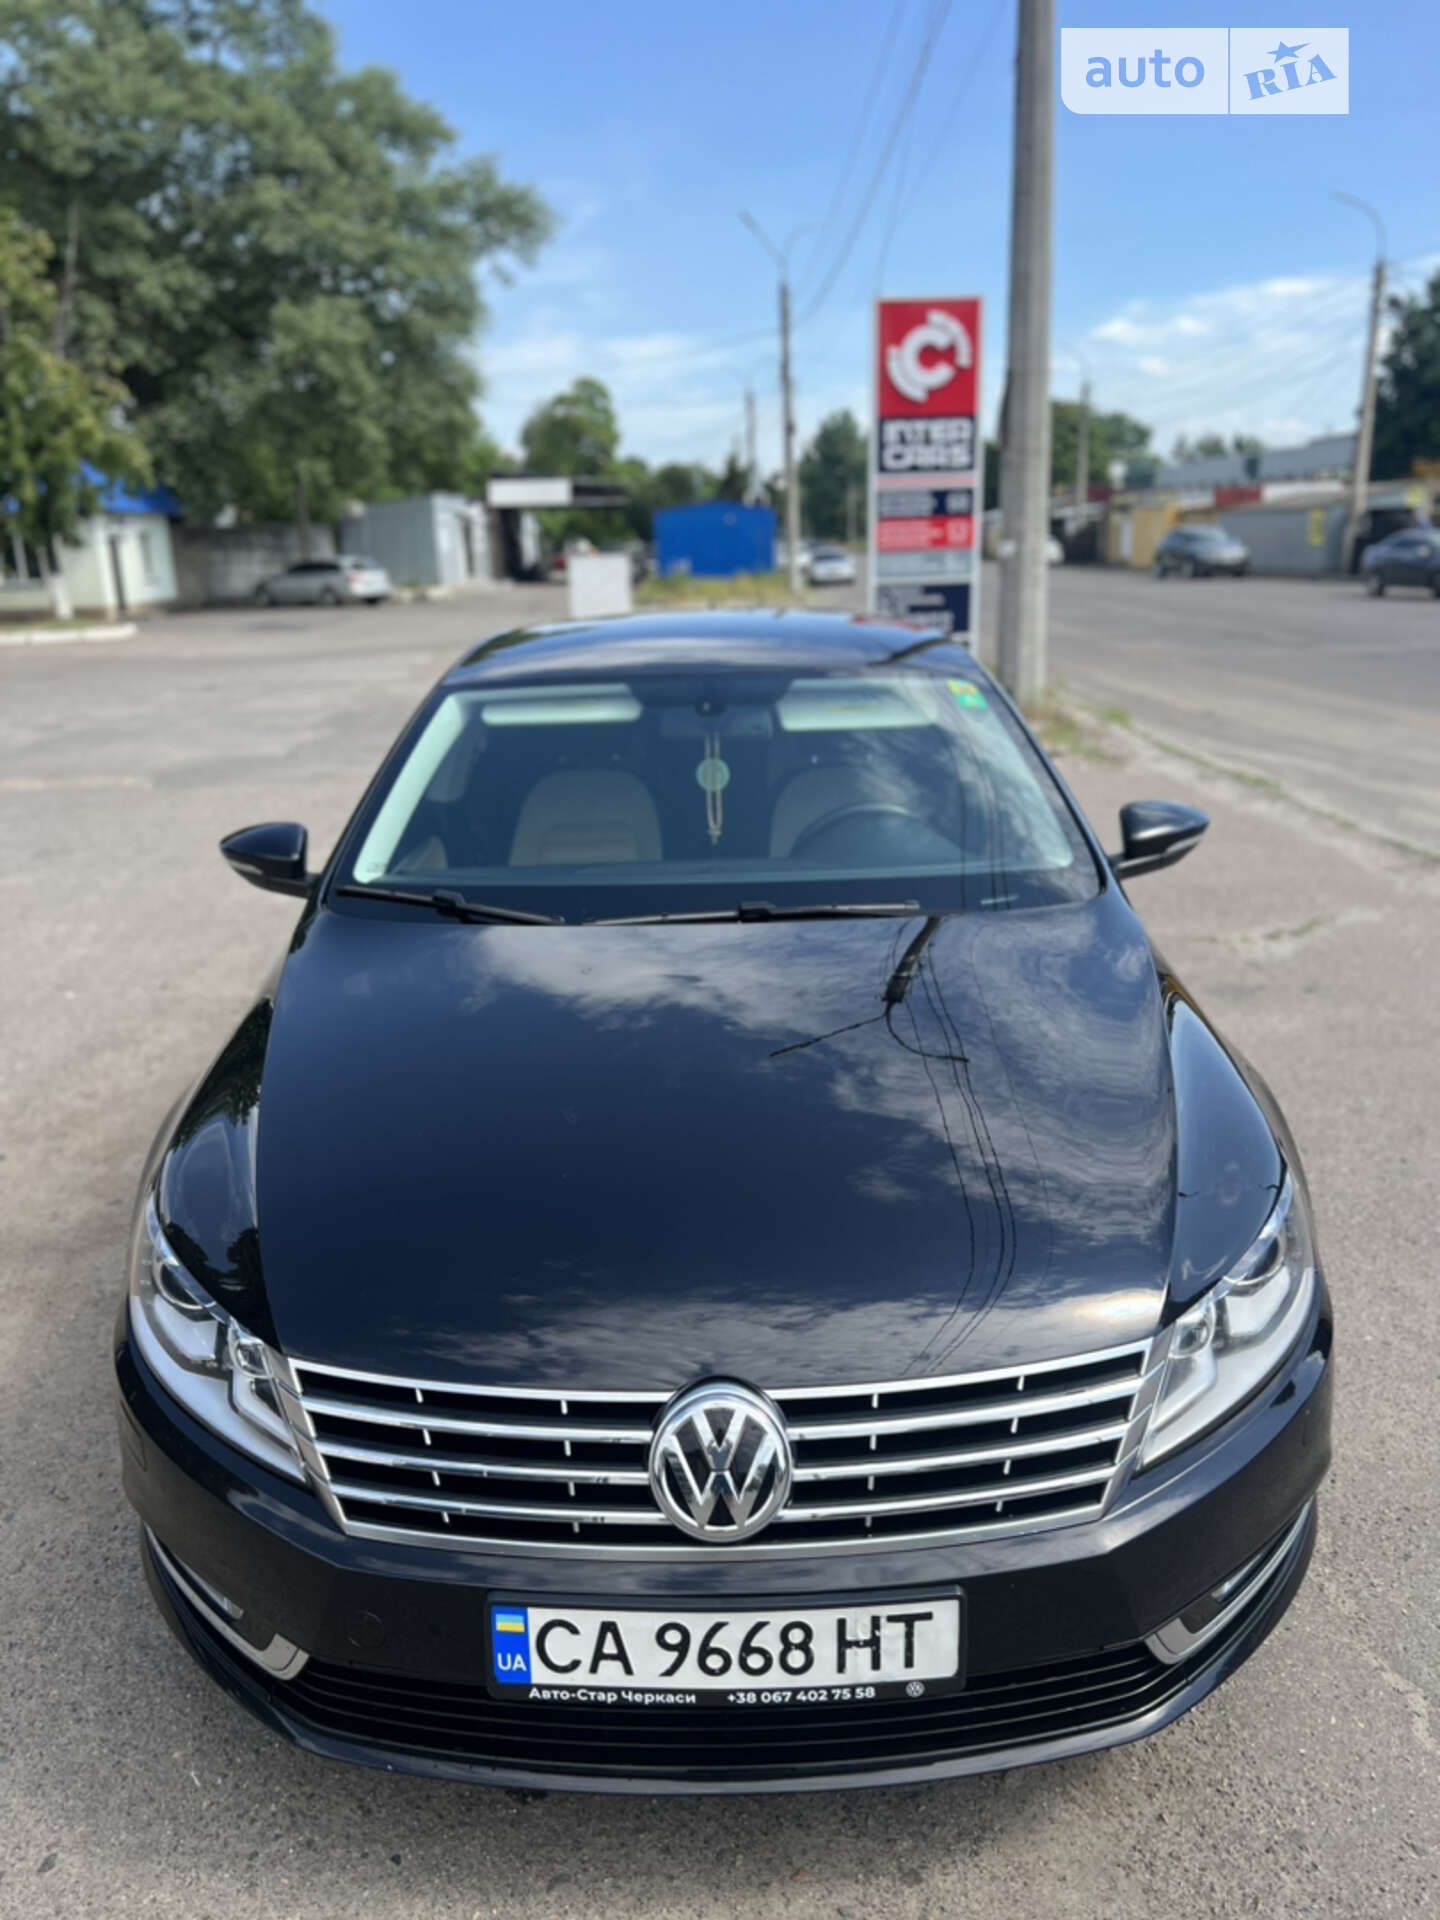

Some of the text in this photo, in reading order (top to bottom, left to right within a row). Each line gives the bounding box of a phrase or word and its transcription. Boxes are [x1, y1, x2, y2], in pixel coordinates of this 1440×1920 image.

[535, 1611, 934, 1677] CA 9668 HT
[497, 1652, 527, 1672] UA
[528, 1686, 697, 1706] Авто-Стар Черкаси
[727, 1685, 877, 1704] +38 067 402 75 58
